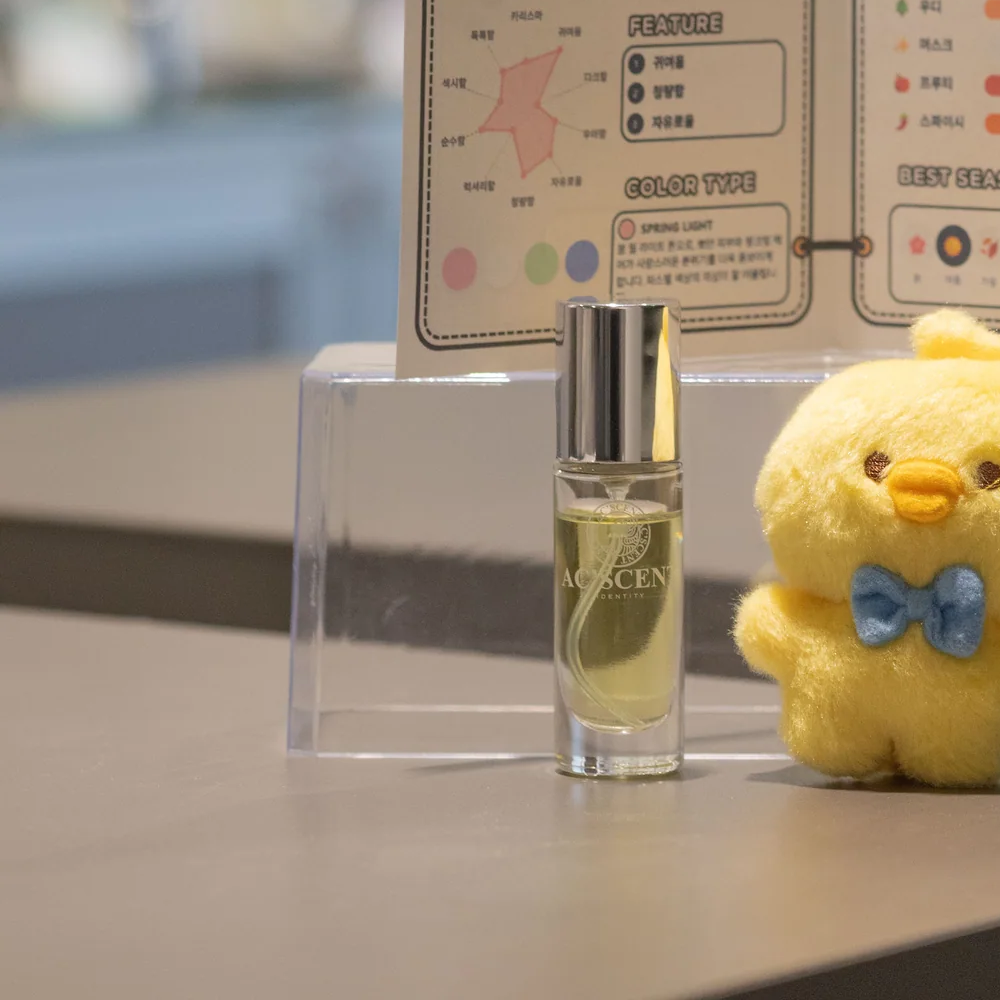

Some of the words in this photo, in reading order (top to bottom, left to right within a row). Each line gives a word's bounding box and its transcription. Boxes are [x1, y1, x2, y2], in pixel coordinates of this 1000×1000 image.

[919, 0, 941, 14] 우디
[628, 12, 723, 37] FEATURE
[919, 38, 953, 51] 머스크
[920, 76, 953, 90] 프루티
[919, 114, 965, 129] 스파이시
[898, 165, 952, 187] BEST
[624, 174, 698, 199] COLOR
[702, 170, 757, 195] TYPE
[641, 222, 679, 234] SPRING
[682, 220, 713, 232] LIGHT
